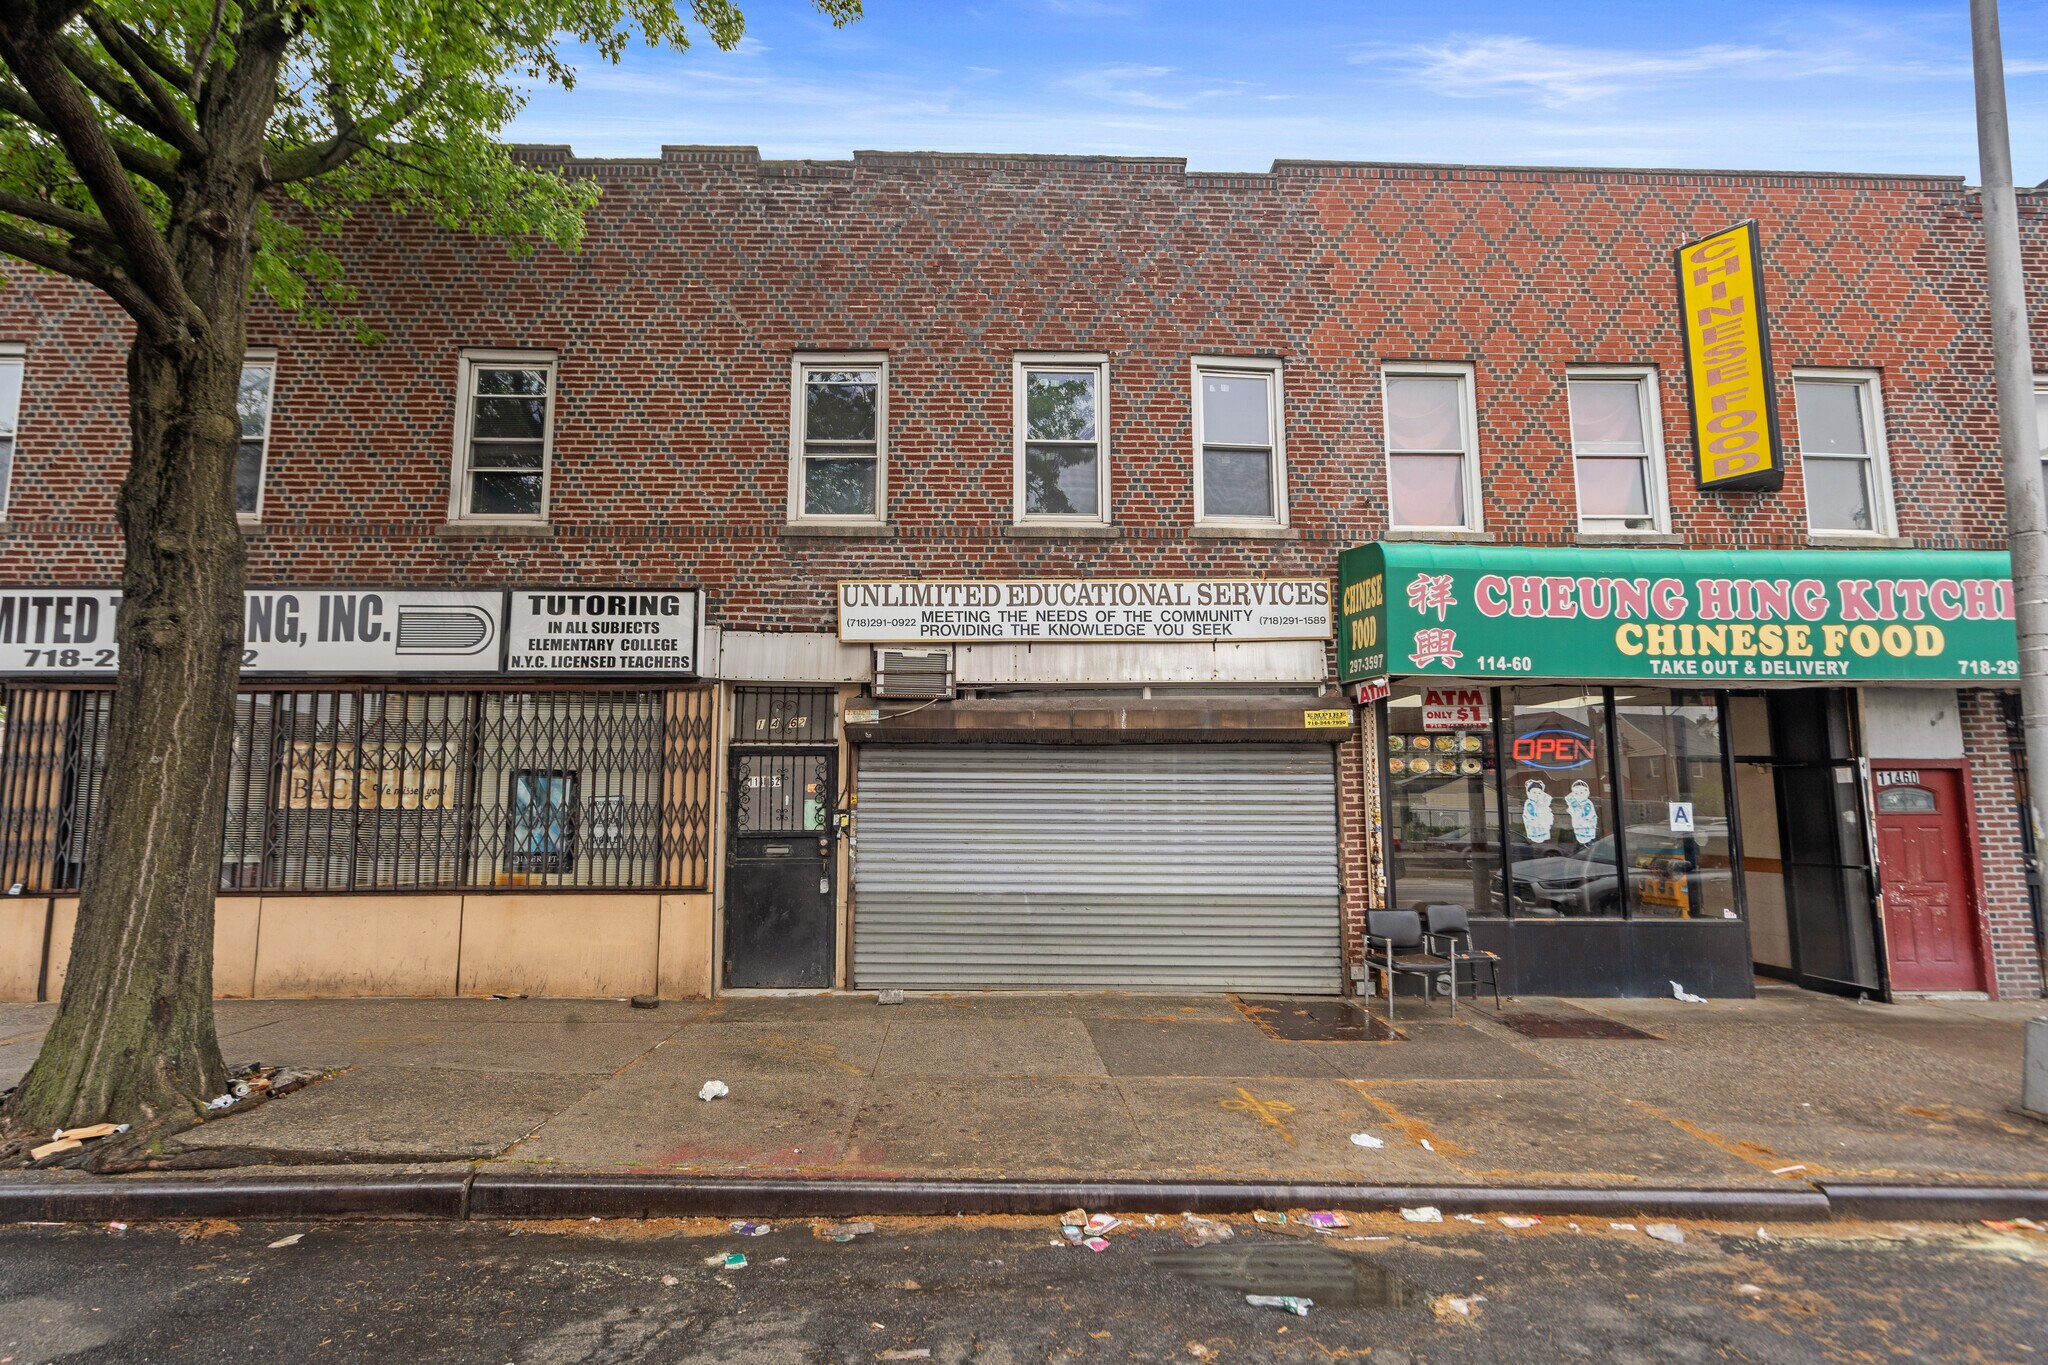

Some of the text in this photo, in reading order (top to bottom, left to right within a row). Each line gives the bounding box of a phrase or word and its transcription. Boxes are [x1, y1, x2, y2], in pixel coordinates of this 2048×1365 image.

[1691, 237, 1760, 477] CHINESE FOOD
[842, 582, 1329, 607] UNLIMITED EDUCATIONAL SERVICES
[1343, 574, 1383, 616] CHINESE
[1474, 574, 1689, 620] CHEUNG
[1696, 578, 1830, 622] HING
[528, 595, 680, 616] TUTORING
[318, 594, 390, 643] INC.
[846, 618, 917, 628] (718)291-0922
[921, 610, 1253, 623] MEETING THE NEEDS OF THE COMMUNITY
[1259, 616, 1327, 626] (718)291-1589
[548, 621, 660, 634] IN ALL SUBJECTS
[920, 623, 1232, 636] PROVIDING THE KNOWLEDGE YOU SEEK
[1352, 615, 1377, 651] FOOD
[528, 638, 678, 651] ELEMENTARY COLLEGE
[1615, 623, 1945, 658] CHINESE FOOD
[511, 656, 690, 668] N.Y.C. LICENSED TEACHERS
[1349, 653, 1383, 674] 297-3597
[1477, 656, 1532, 671] 114-60
[1650, 660, 1850, 675] TAKE OUT & DELIVERY
[1958, 660, 2020, 675] 718-29
[1360, 683, 1389, 703] ATM
[1424, 690, 1484, 706] ATM
[1426, 706, 1481, 721] ONLY $1
[1513, 738, 1595, 760] OPEN
[1878, 771, 1918, 785] 11460
[292, 778, 369, 800] BACK
[393, 784, 425, 795] misse
[1674, 806, 1689, 823] A
